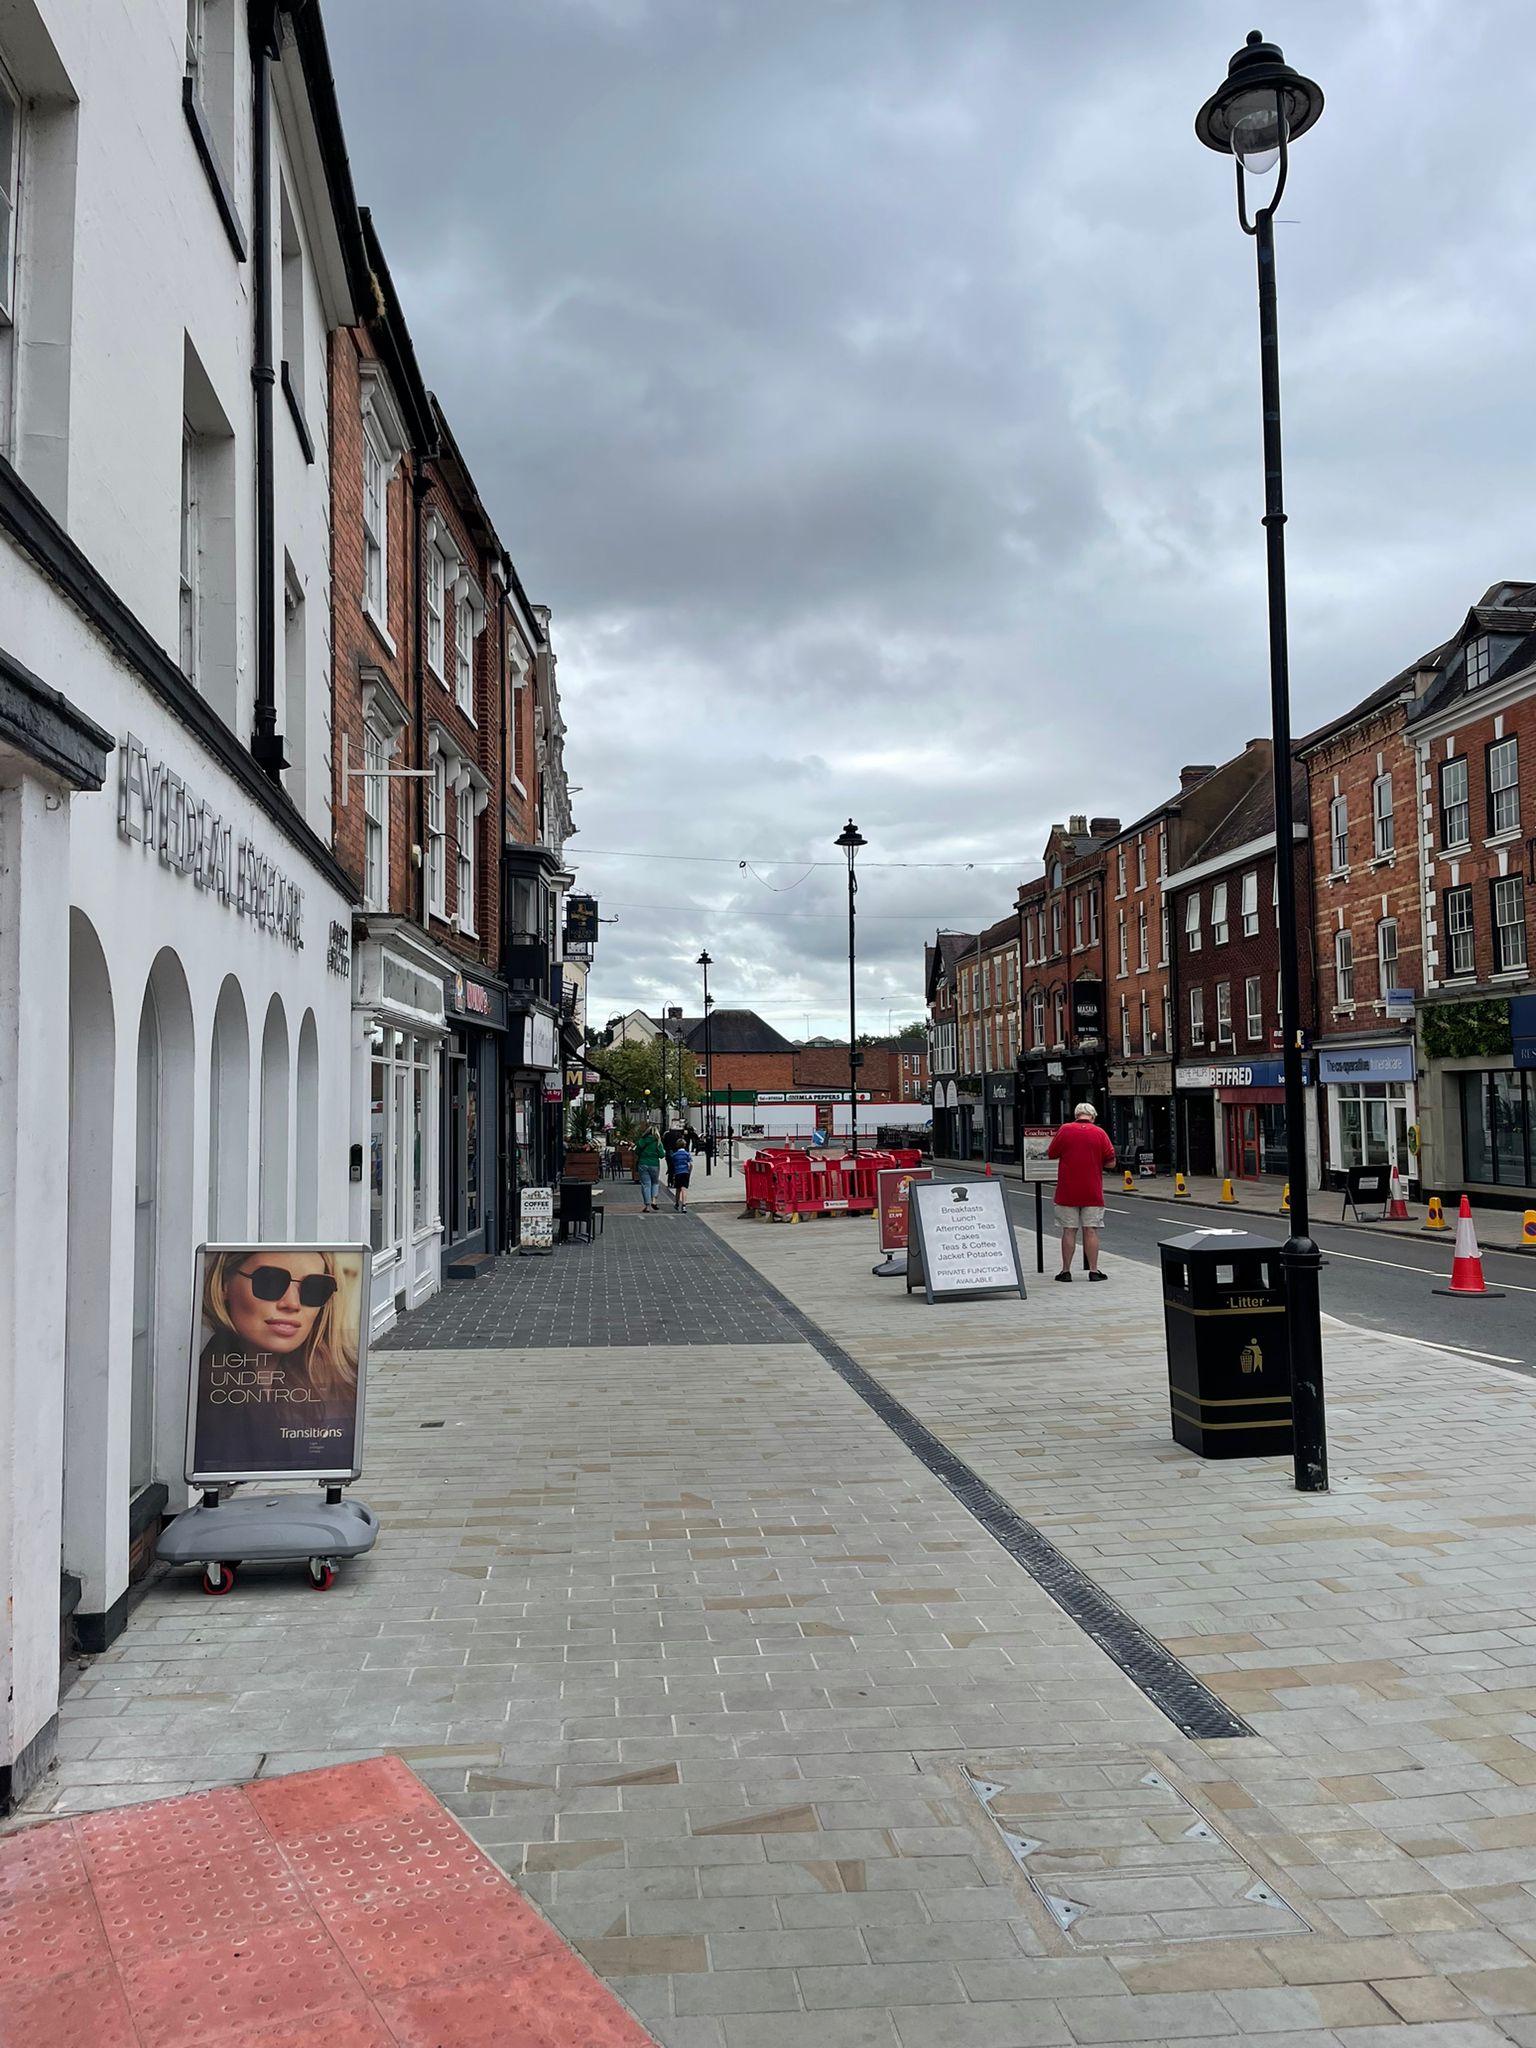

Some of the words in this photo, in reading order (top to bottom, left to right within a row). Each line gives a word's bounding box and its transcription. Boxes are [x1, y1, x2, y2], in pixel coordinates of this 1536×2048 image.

[124, 731, 237, 906] EYEDEAL
[242, 836, 305, 950] EYECARE
[1077, 1005, 1098, 1013] MASALA
[1209, 1067, 1252, 1086] BETFRED
[941, 1205, 984, 1214] Breakfasts
[951, 1214, 976, 1223] Lunch
[935, 1223, 975, 1233] Afternoon
[977, 1222, 995, 1230] Teas
[954, 1232, 980, 1241] Cakes
[941, 1243, 960, 1251] Teas
[961, 1242, 968, 1250] &
[969, 1240, 997, 1249] Coffee
[938, 1252, 965, 1261] Jacket
[967, 1250, 1003, 1259] Potatoes
[937, 1268, 966, 1277] PRIVATE
[967, 1265, 1008, 1275] FUNCTIONS
[955, 1276, 993, 1285] AVAILABLE
[1230, 1297, 1264, 1308] Litter
[211, 1352, 273, 1368] LIGHT
[210, 1370, 286, 1386] UNDER
[209, 1387, 321, 1404] CONTROL
[280, 1427, 343, 1439] Transitions
